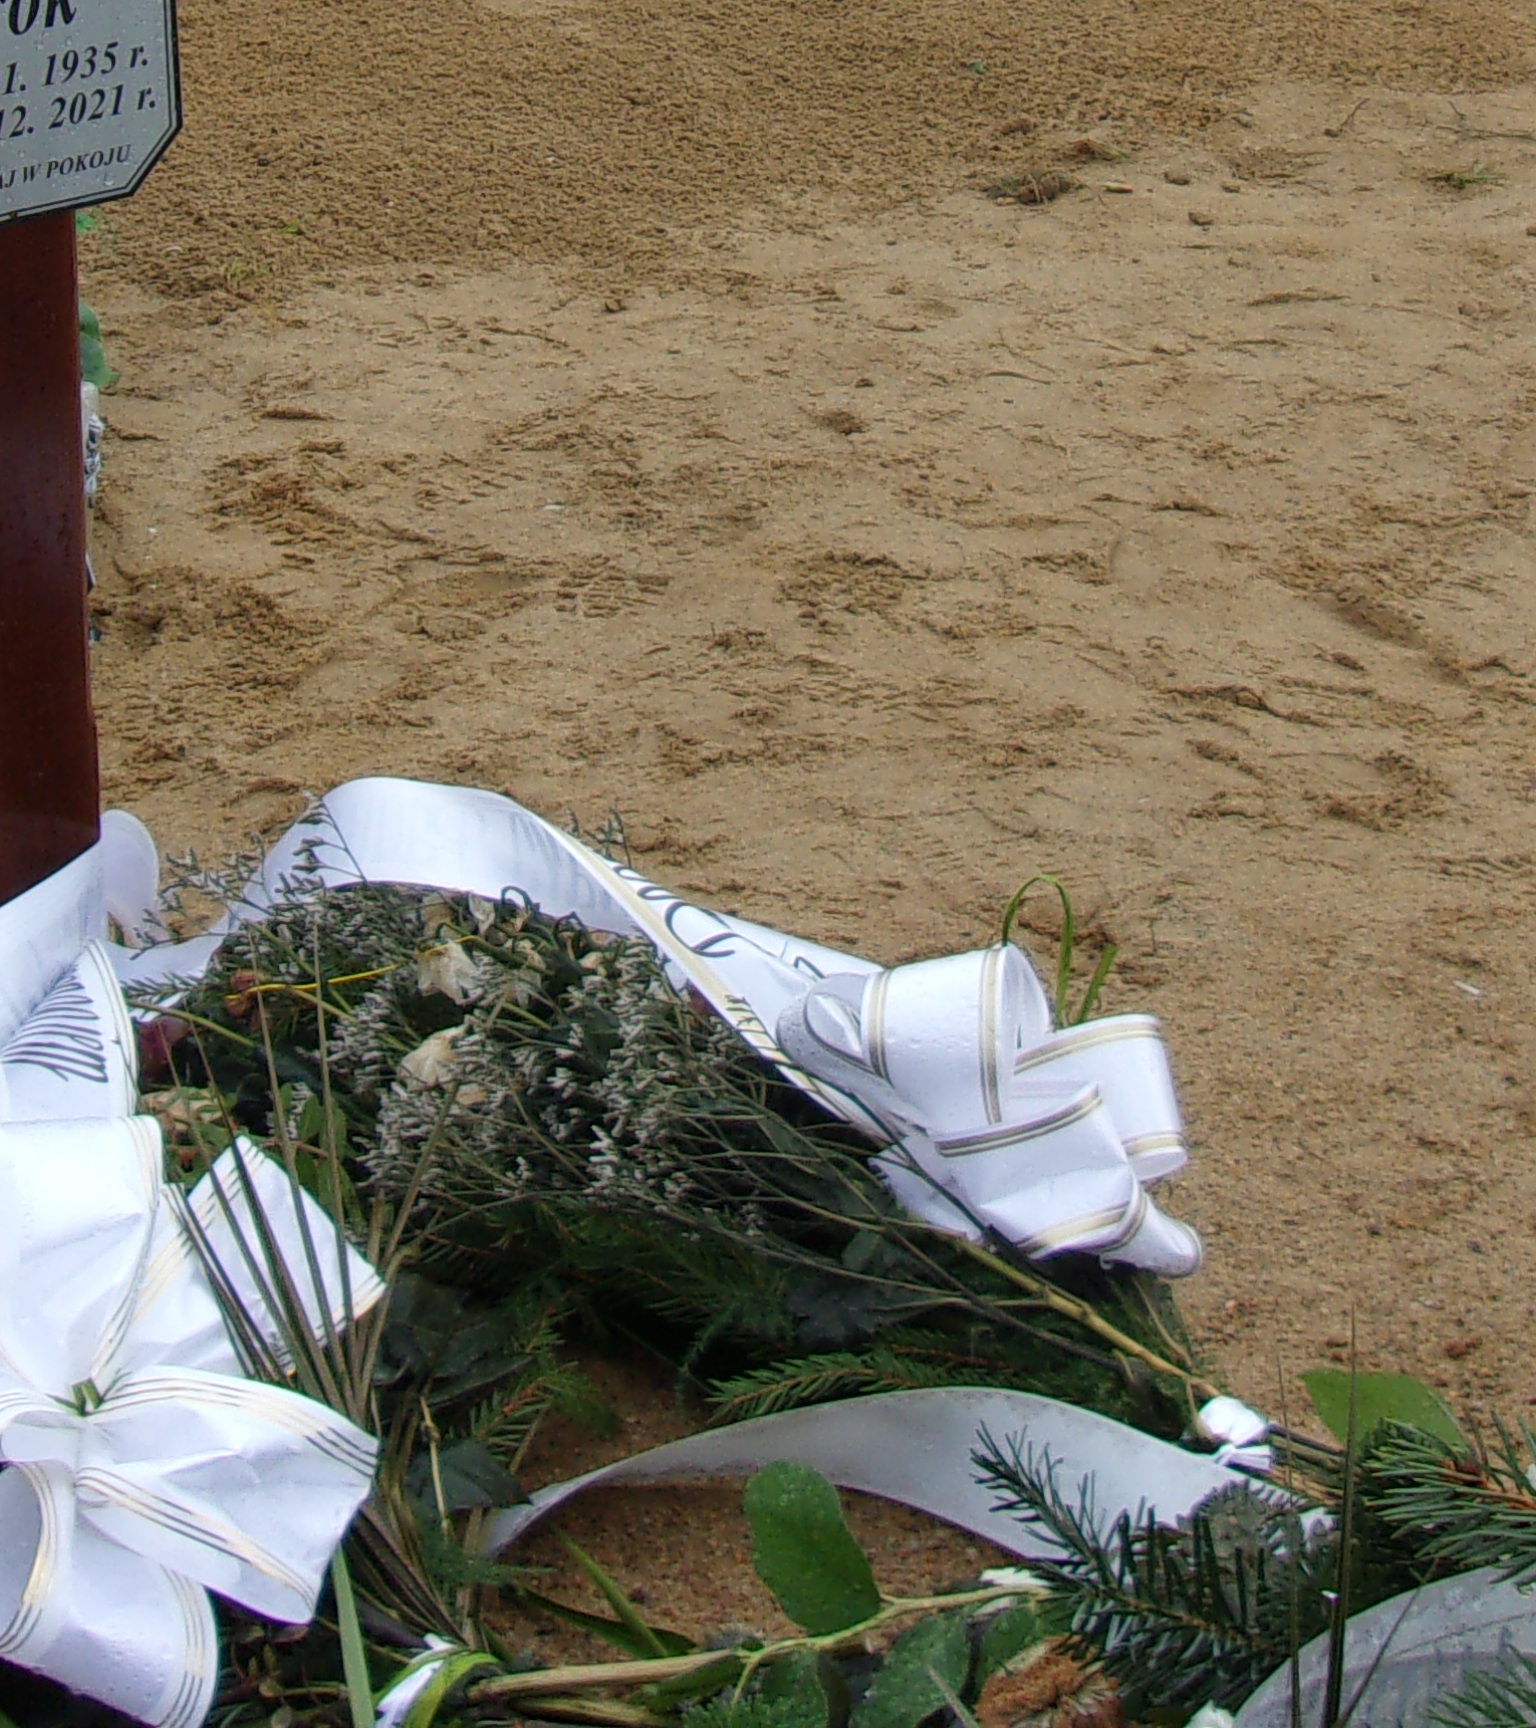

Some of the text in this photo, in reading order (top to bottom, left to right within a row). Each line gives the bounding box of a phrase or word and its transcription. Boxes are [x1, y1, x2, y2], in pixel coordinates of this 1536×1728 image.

[42, 41, 118, 87] 1935
[129, 44, 148, 69] r.
[47, 84, 124, 130] 2021
[136, 86, 156, 112] r.
[21, 164, 42, 184] W
[46, 143, 133, 180] POKOJU
